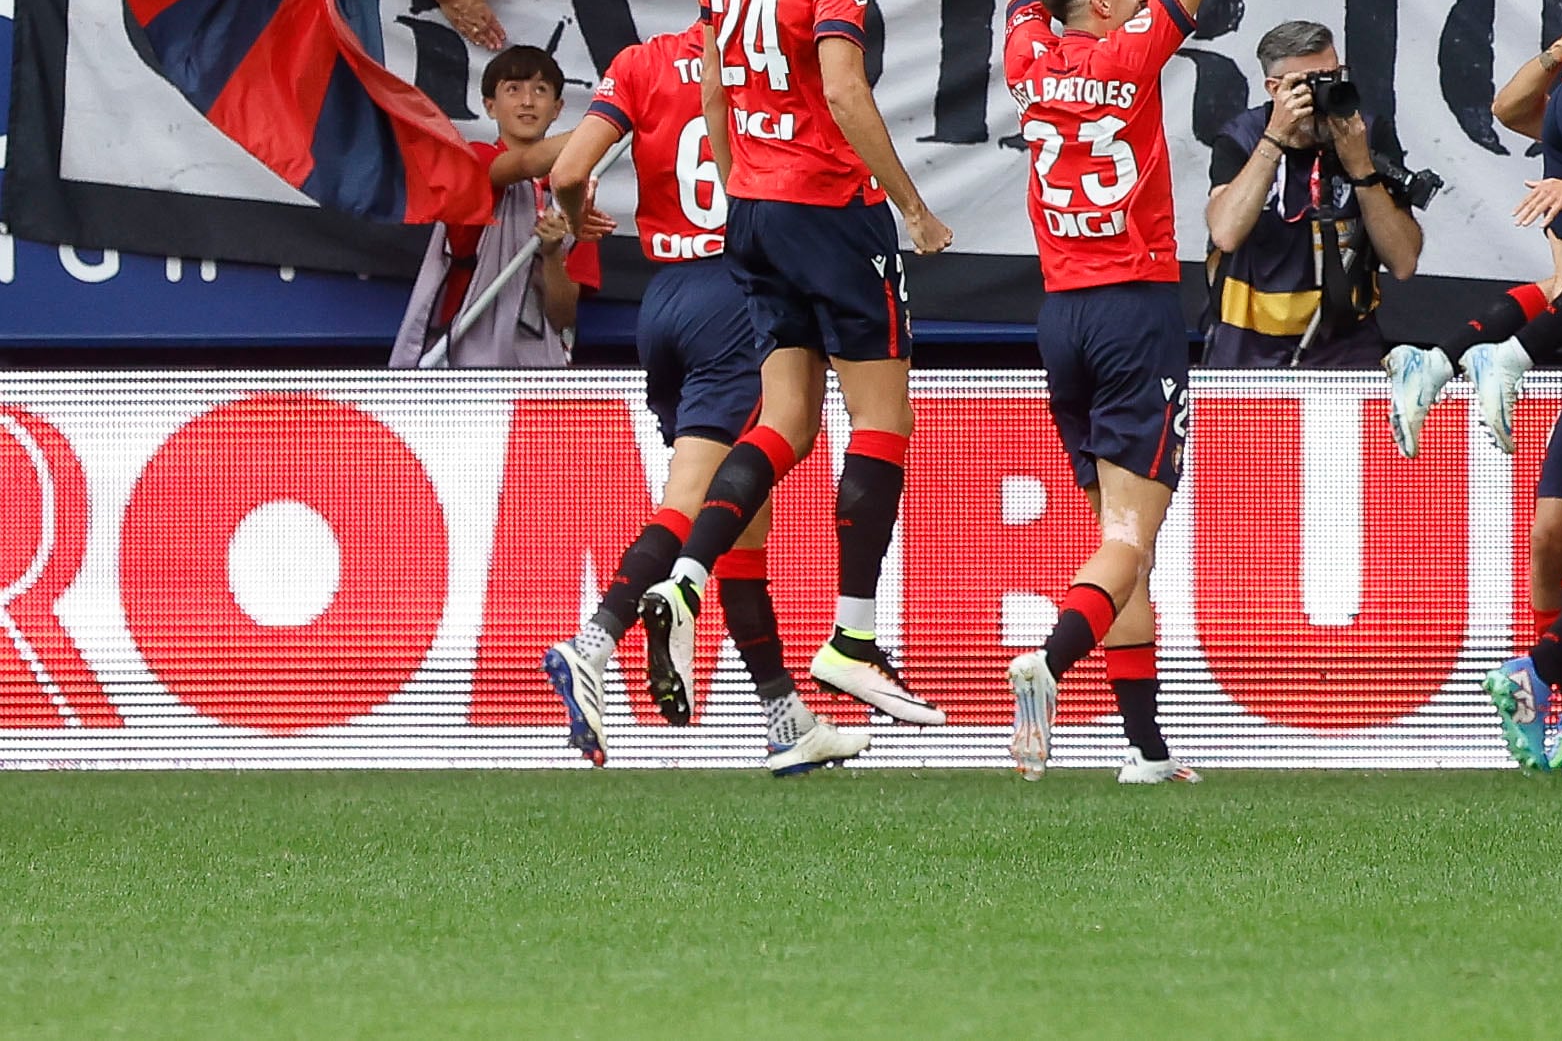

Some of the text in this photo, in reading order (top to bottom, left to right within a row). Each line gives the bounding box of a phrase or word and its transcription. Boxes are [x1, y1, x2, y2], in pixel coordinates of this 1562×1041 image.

[675, 115, 728, 231] 6
[1023, 114, 1140, 208] 23
[1043, 208, 1128, 238] DIGI
[1174, 389, 1189, 439] 2
